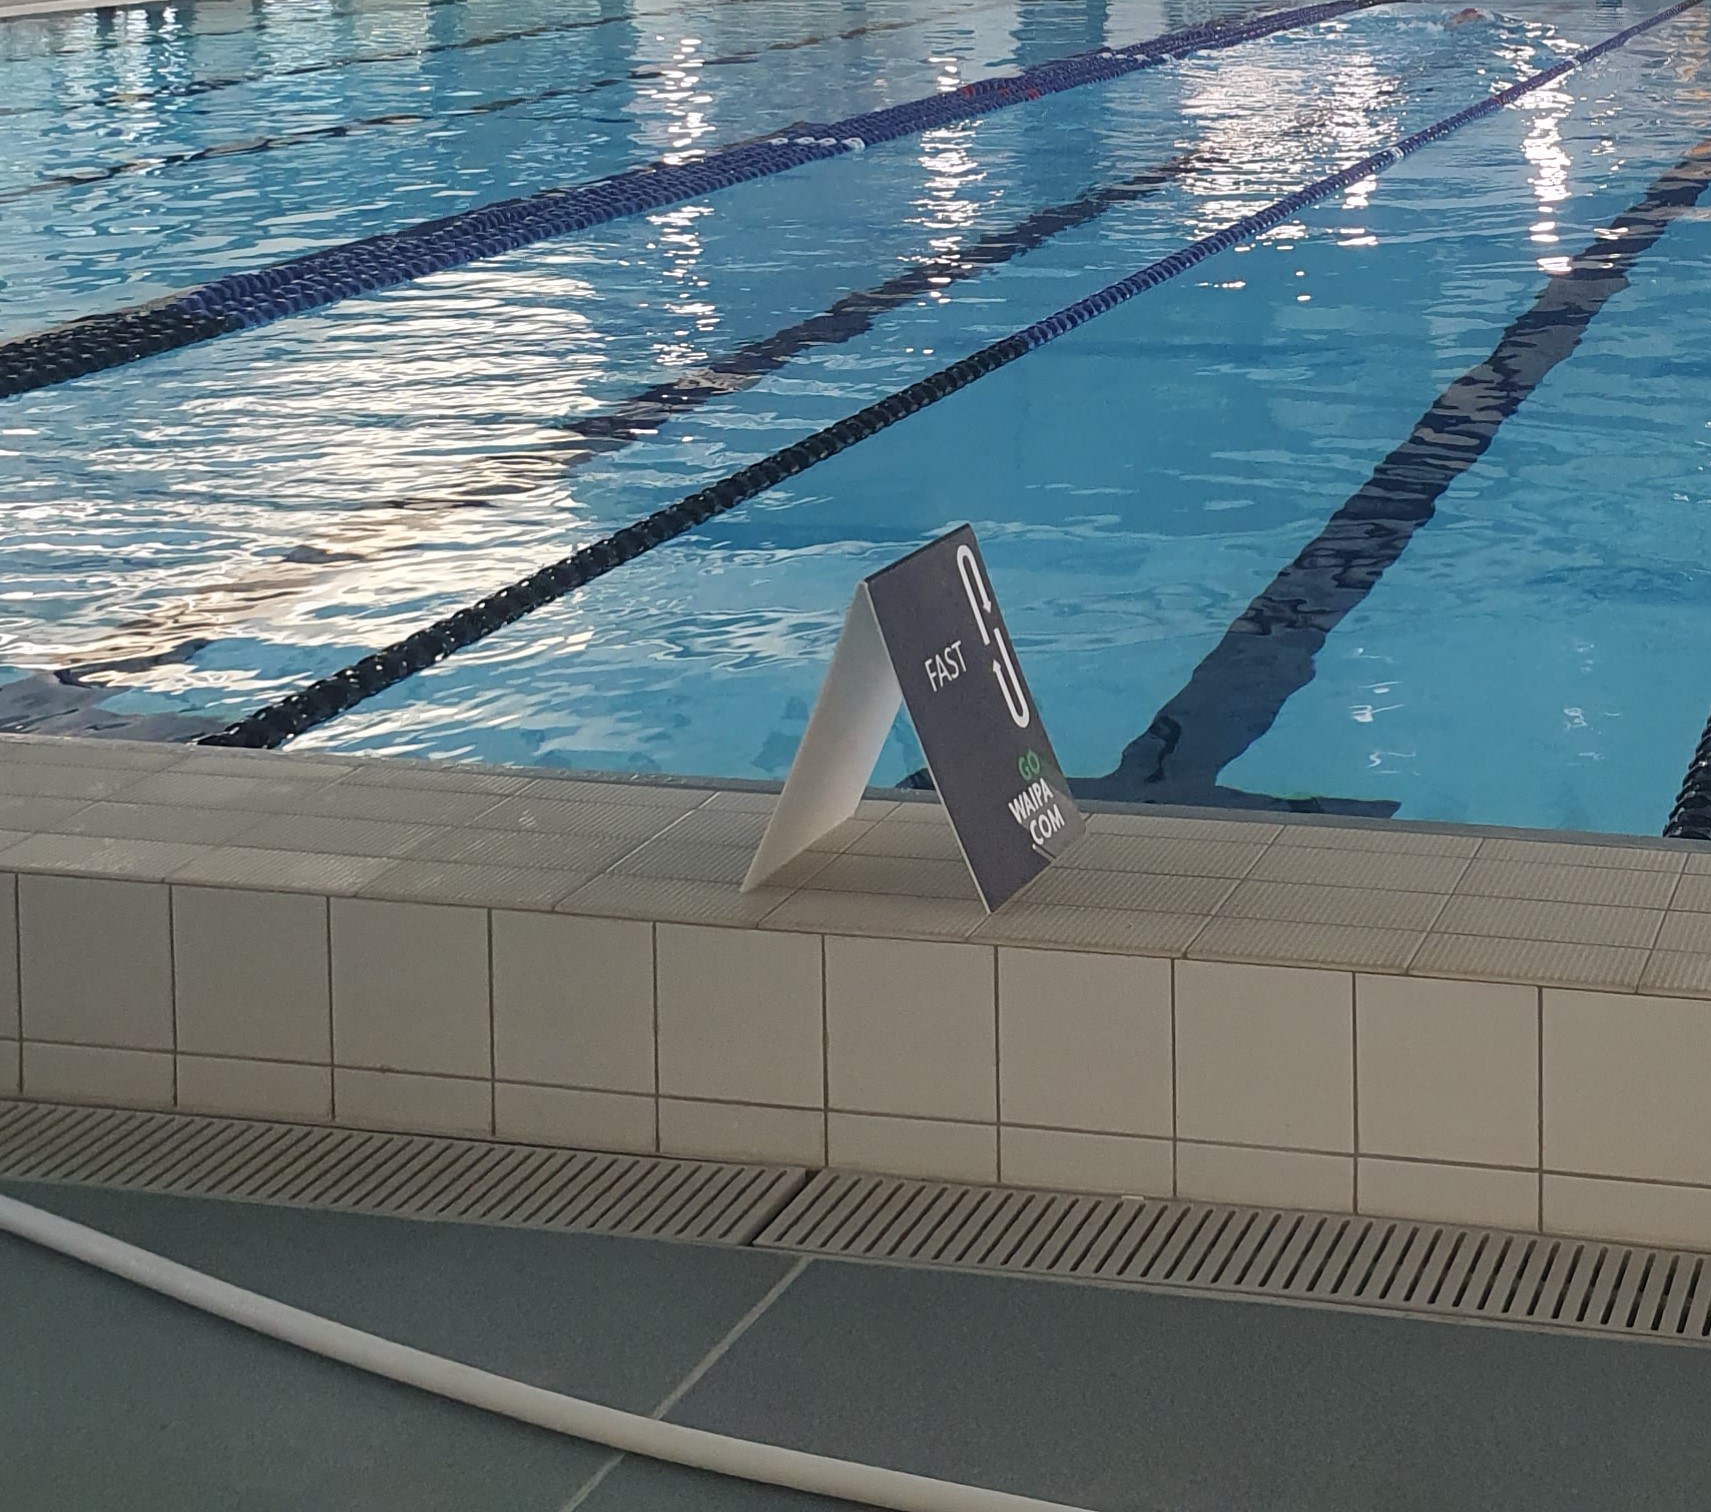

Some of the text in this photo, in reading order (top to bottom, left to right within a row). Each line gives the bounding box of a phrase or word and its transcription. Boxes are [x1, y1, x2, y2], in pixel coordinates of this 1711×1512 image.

[924, 639, 967, 692] FAST
[1018, 750, 1040, 780] GO
[1007, 777, 1054, 824] WAIPA
[1029, 803, 1066, 850] .COM
